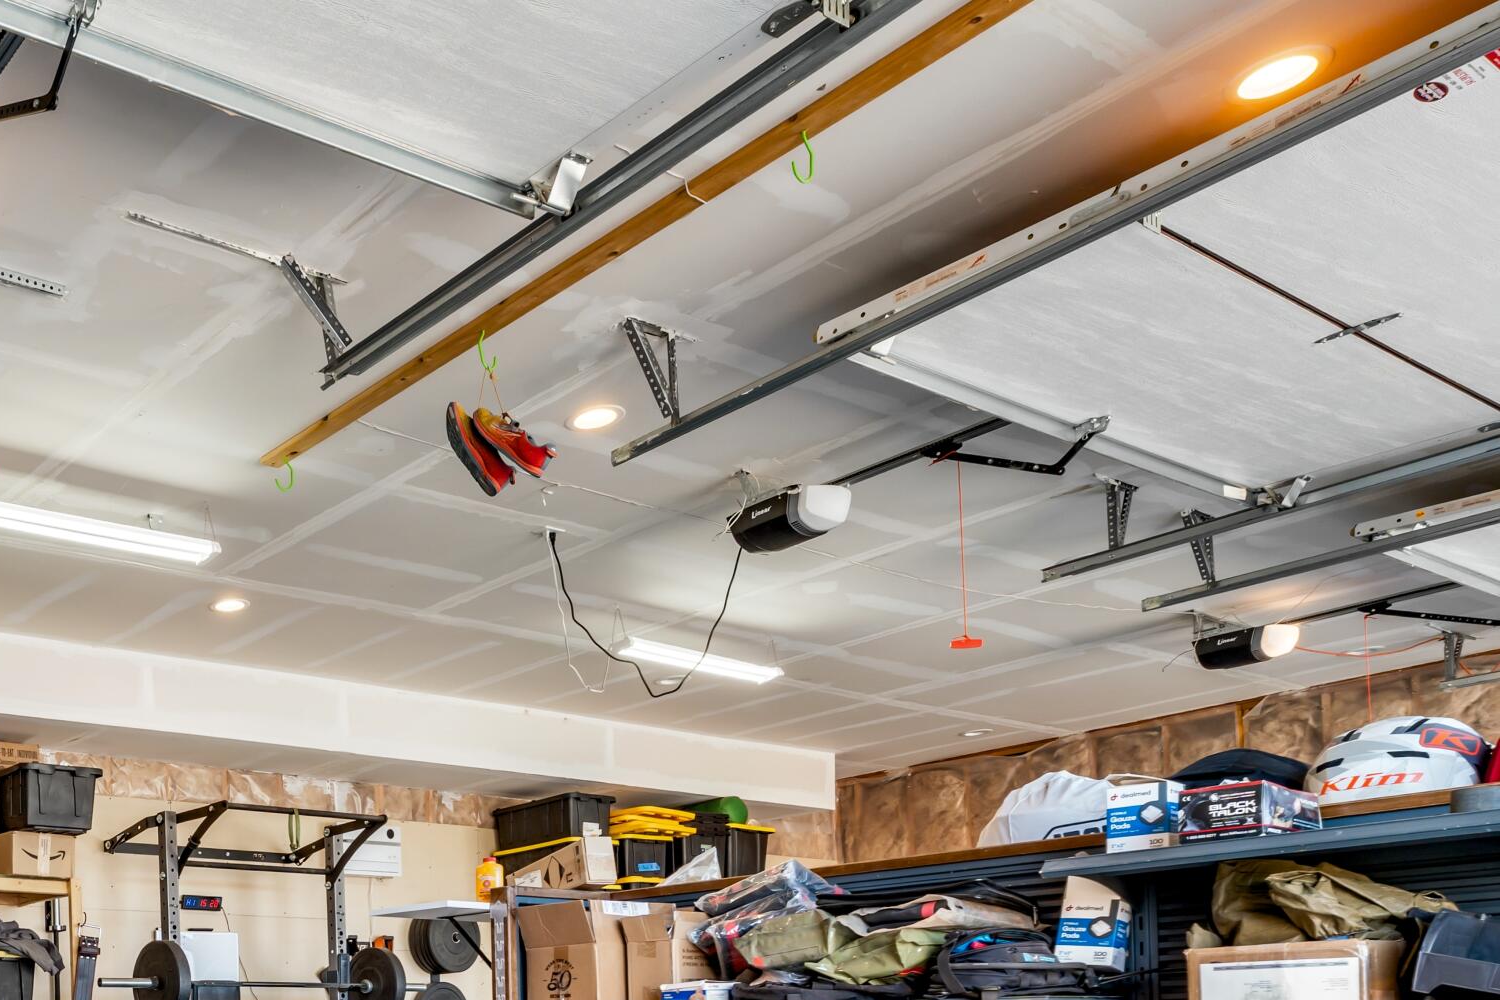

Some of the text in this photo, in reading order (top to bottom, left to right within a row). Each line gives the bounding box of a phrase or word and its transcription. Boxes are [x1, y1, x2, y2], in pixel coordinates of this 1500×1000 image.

[751, 505, 773, 520] Linear
[1217, 636, 1239, 646] Linear
[1120, 790, 1152, 799] dealmed
[1208, 800, 1256, 812] BLACK
[1208, 806, 1257, 818] TALON
[1109, 816, 1137, 824] Gauze
[1110, 823, 1131, 831] Pads
[547, 969, 572, 991] 50
